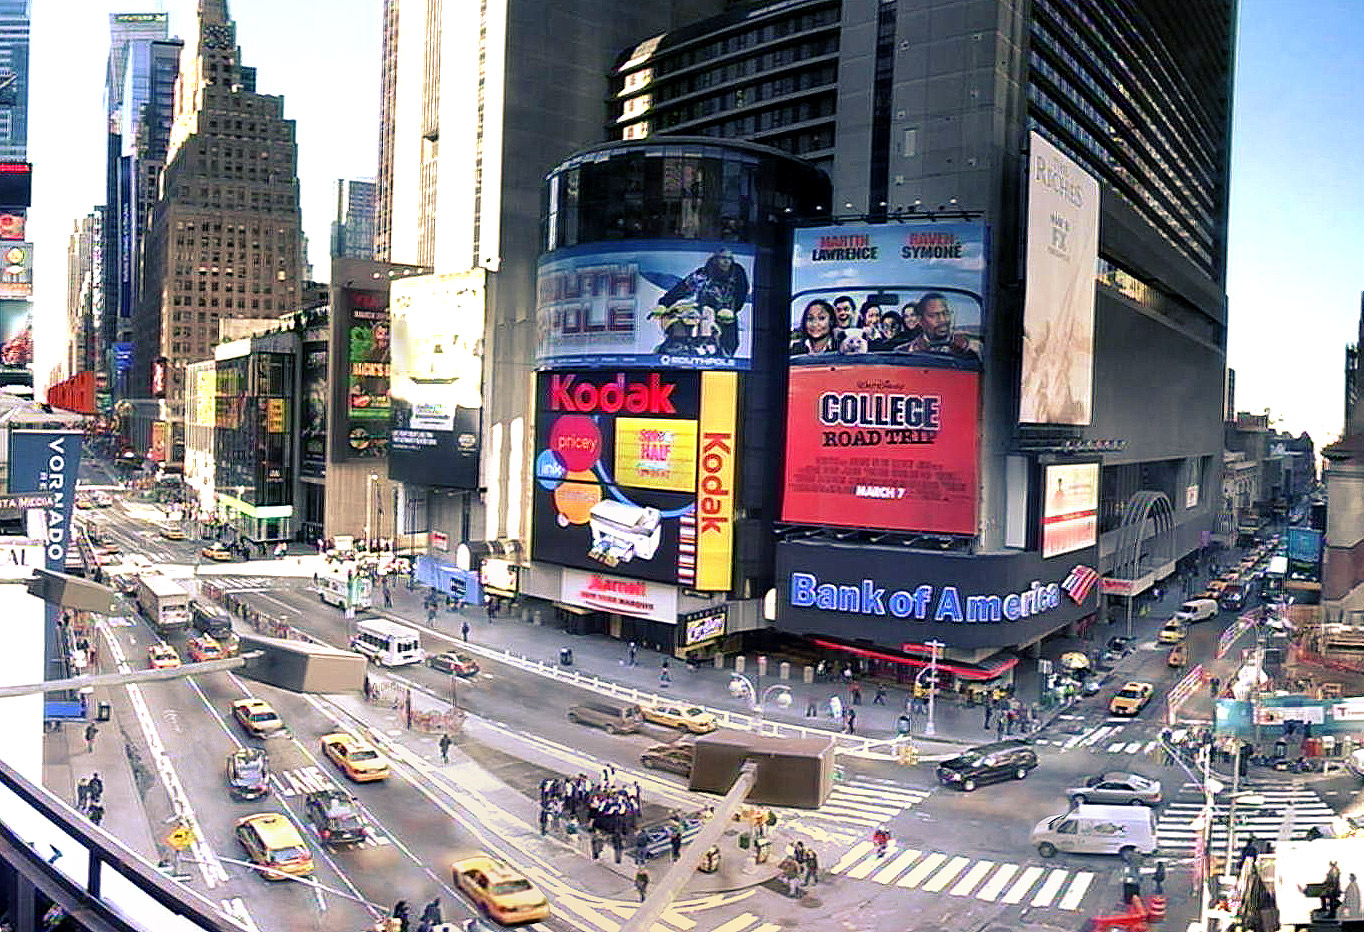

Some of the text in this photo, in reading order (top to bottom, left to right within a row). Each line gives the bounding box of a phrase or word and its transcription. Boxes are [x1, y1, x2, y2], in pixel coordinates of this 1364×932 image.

[812, 246, 879, 261] LAWRENCE
[551, 373, 677, 414] Kodak
[819, 391, 942, 429] COLLEGE
[823, 428, 938, 448] ROAD TRIP
[48, 437, 65, 561] VORNADO
[701, 432, 732, 534] Kodak
[855, 484, 907, 499] MARCH 7
[790, 571, 1061, 623] Bank of America
